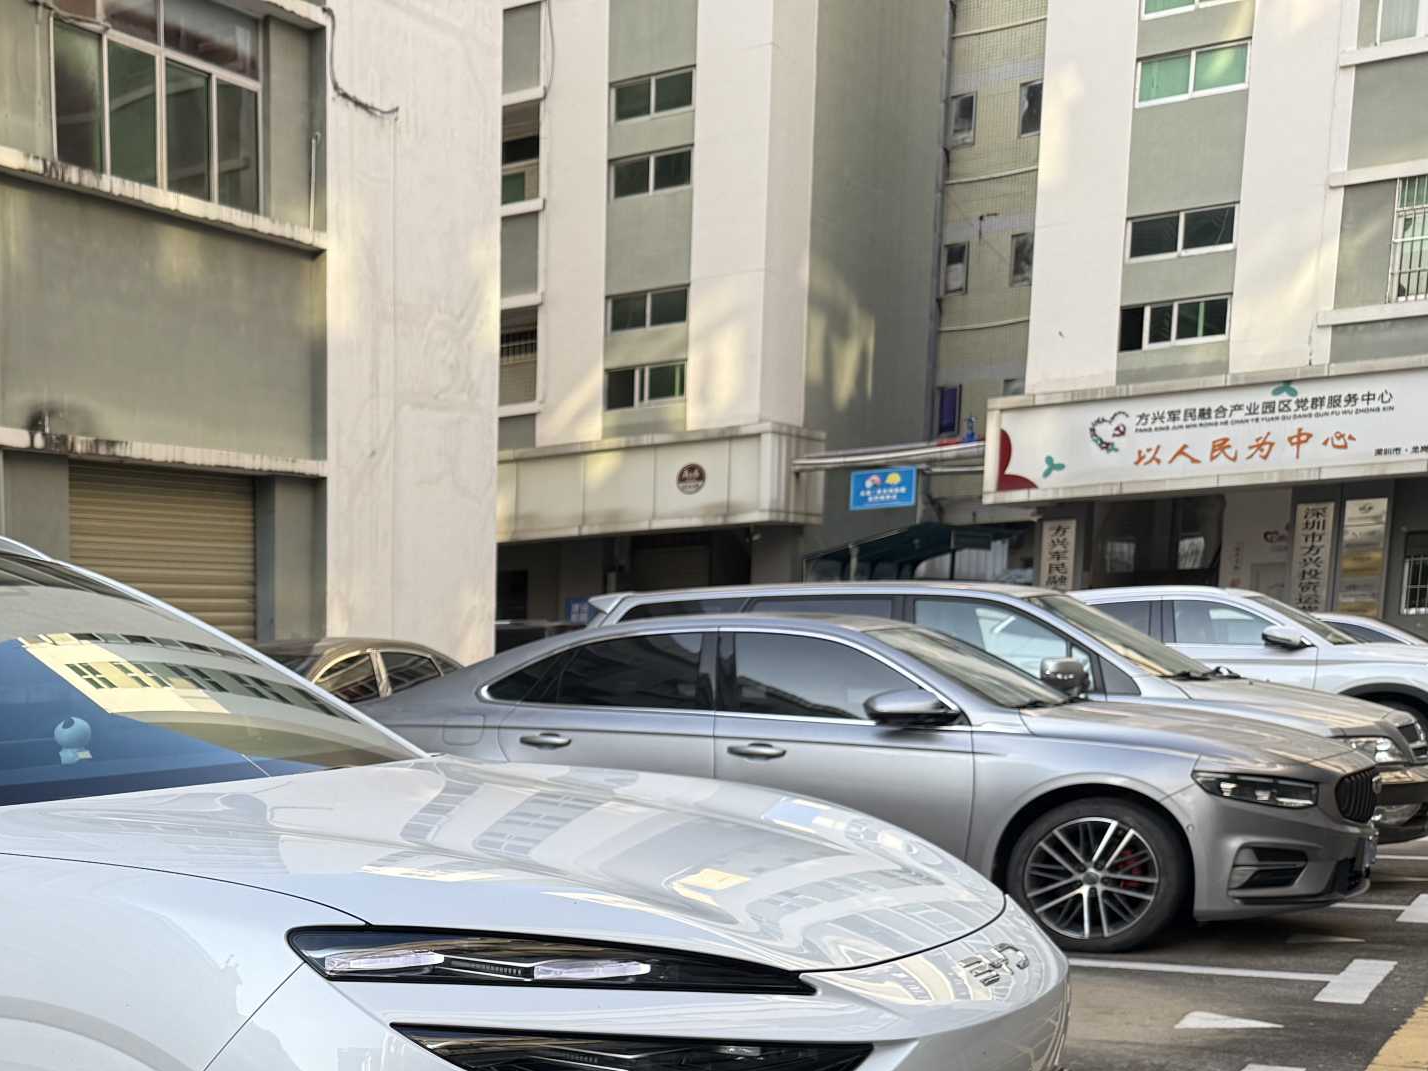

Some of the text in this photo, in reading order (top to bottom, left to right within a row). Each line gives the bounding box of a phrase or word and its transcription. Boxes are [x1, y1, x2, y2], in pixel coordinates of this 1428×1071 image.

[1135, 389, 1394, 426] 方兴军民融合产业园区党群服务中心
[1133, 426, 1356, 466] 以人民为中心
